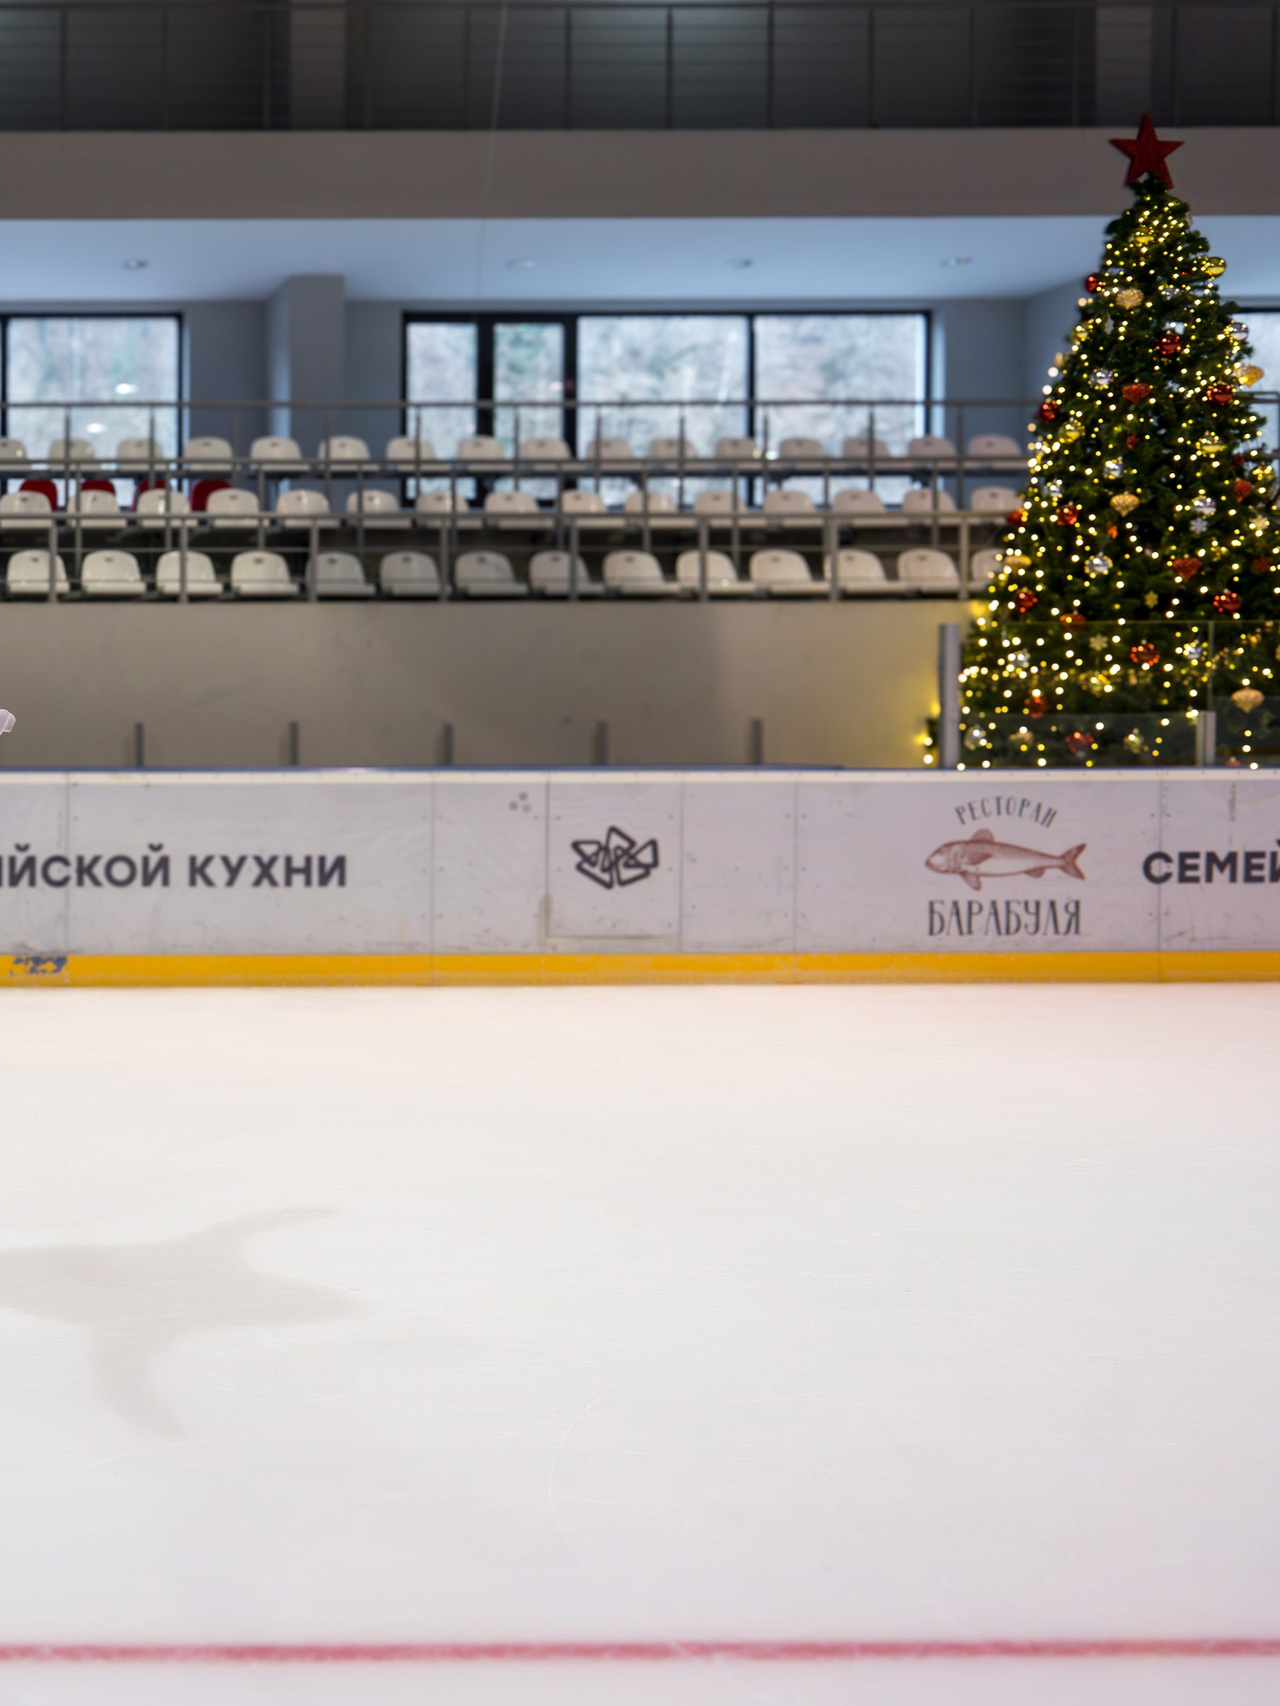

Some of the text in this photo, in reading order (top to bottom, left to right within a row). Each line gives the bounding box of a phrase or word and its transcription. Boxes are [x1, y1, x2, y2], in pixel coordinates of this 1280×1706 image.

[954, 795, 1058, 829] РЕСТОРАН
[187, 854, 348, 888] КУХНИ
[927, 899, 1082, 937] БАРАБУЛЯ
